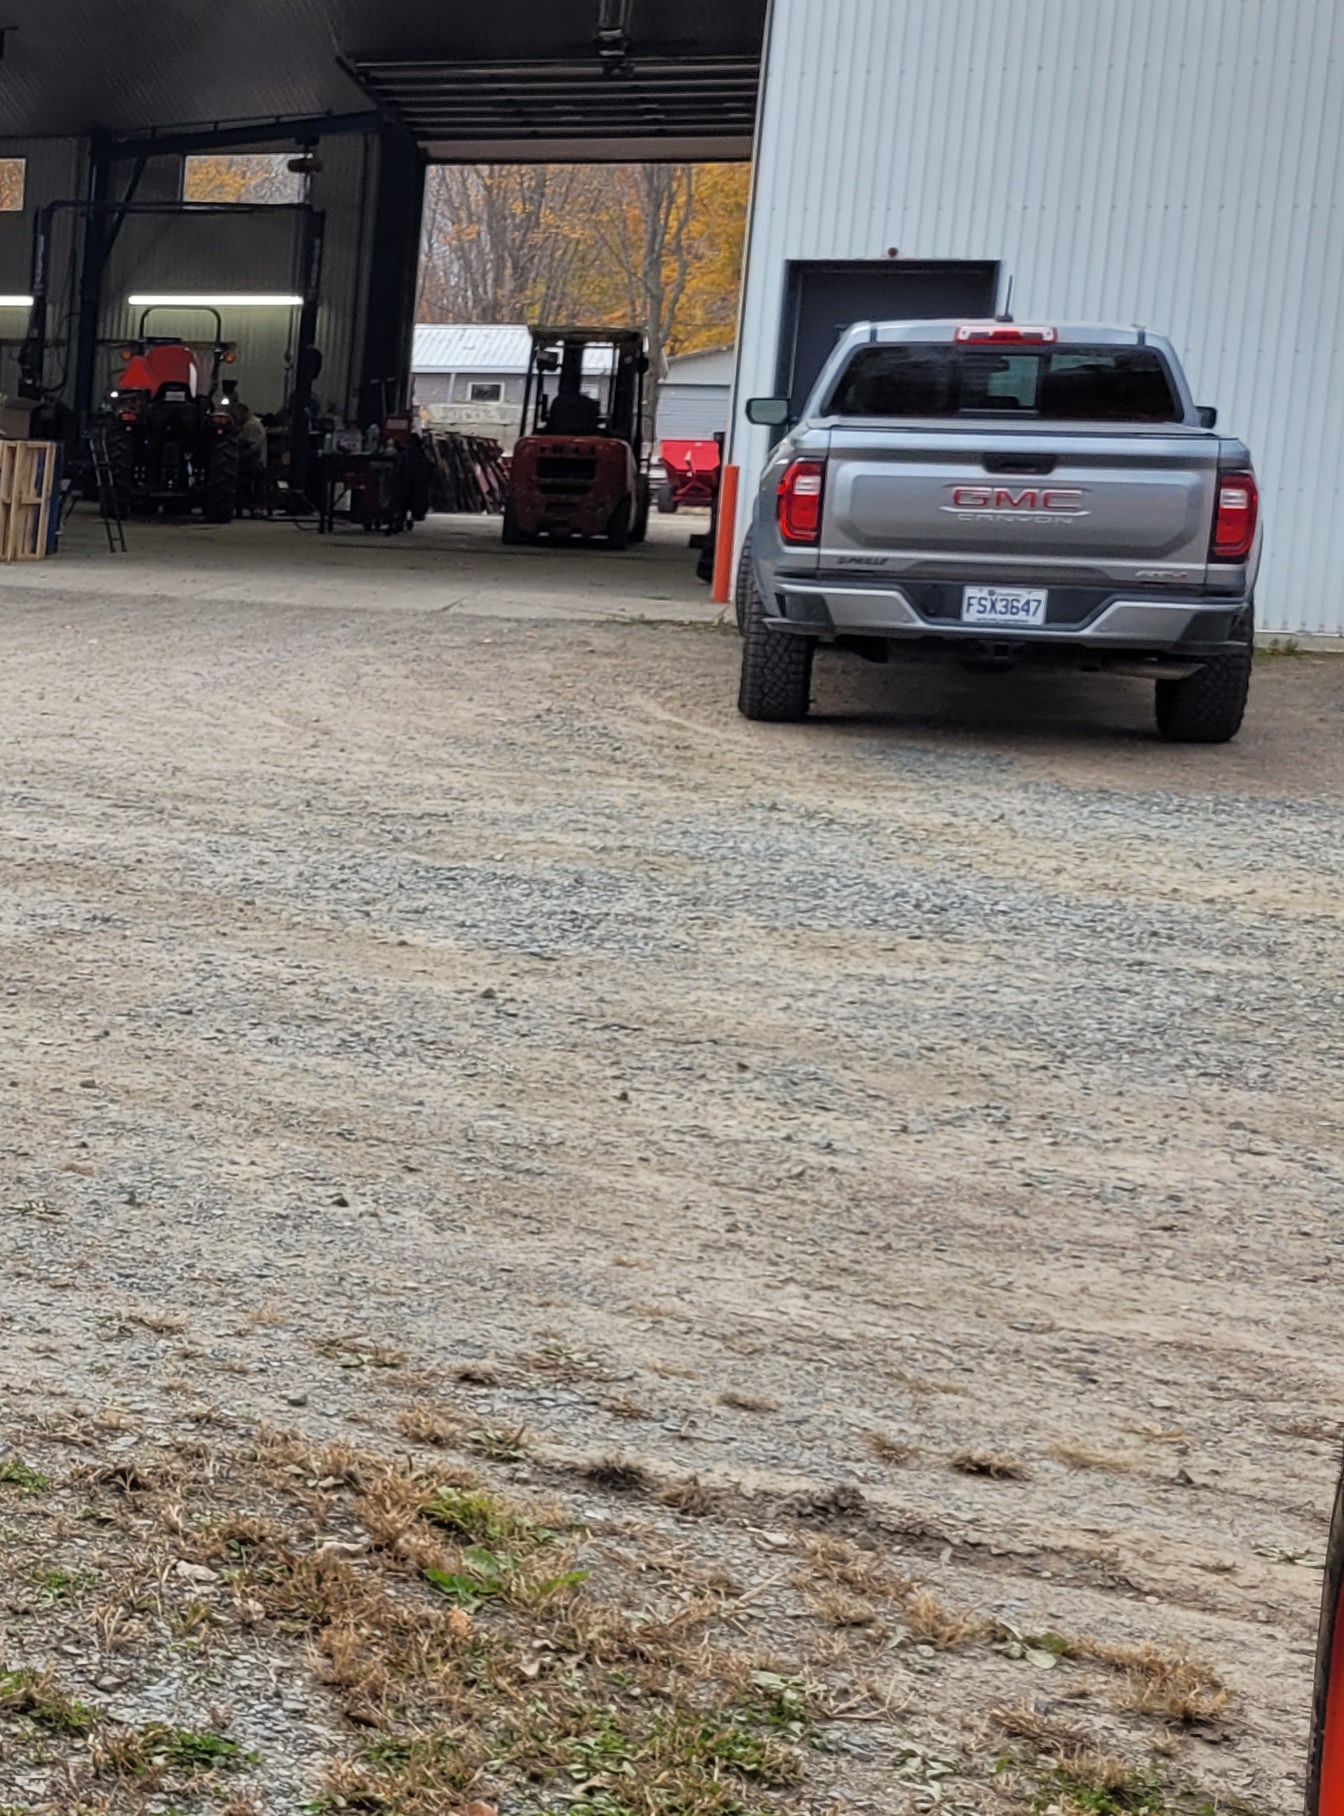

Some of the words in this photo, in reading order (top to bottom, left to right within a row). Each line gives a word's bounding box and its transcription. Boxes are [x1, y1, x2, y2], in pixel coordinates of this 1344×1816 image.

[952, 486, 1083, 510] GMC
[957, 513, 1075, 525] CANYON
[965, 596, 1043, 617] FSX3647
